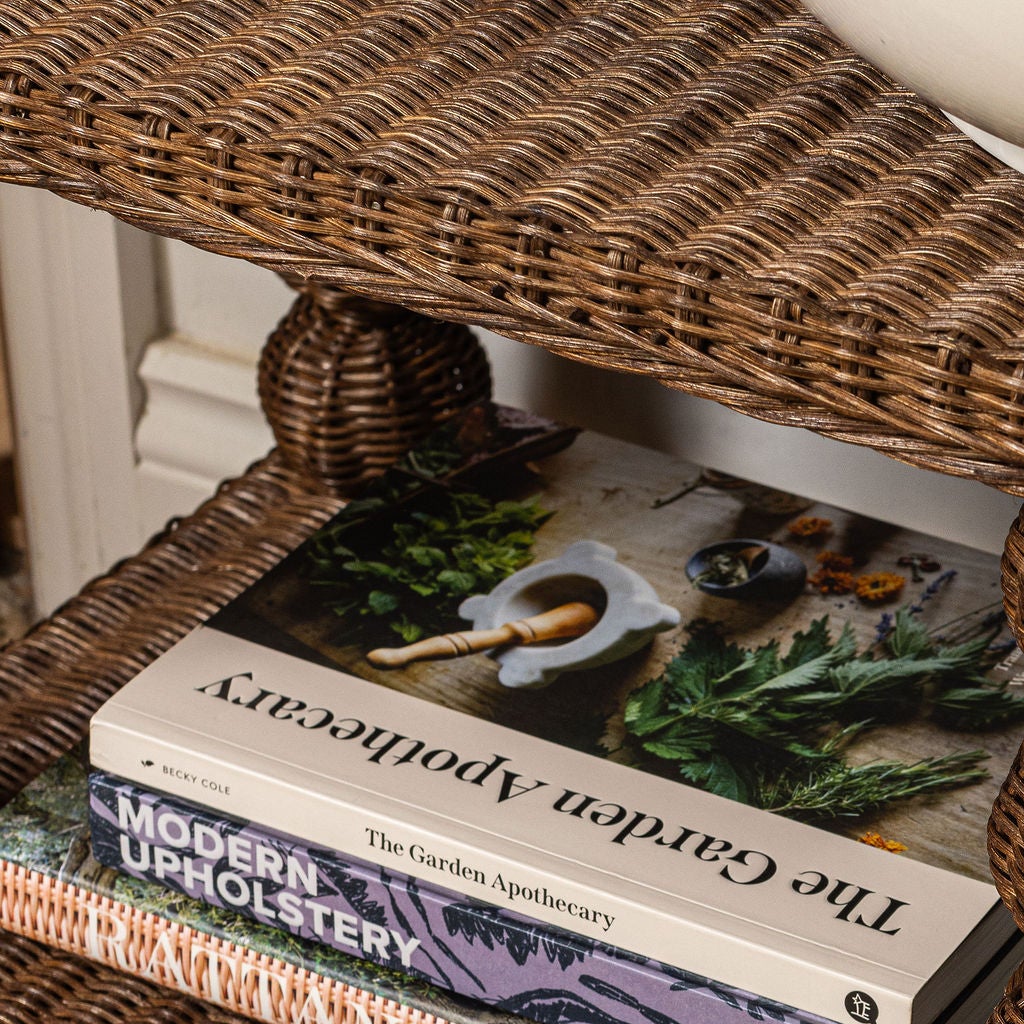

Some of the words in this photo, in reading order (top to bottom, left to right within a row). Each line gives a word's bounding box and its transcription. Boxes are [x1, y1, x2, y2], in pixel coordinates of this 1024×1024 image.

[162, 765, 197, 783] BECKY
[201, 779, 231, 795] COLE
[194, 672, 548, 803] Apothecary
[118, 795, 318, 896] MODERN
[365, 827, 404, 856] The
[409, 844, 486, 884] Garden
[491, 873, 616, 932] Apothecary
[552, 789, 777, 886] Garden
[120, 834, 421, 967] UPHOLSTERY
[791, 870, 911, 936] The
